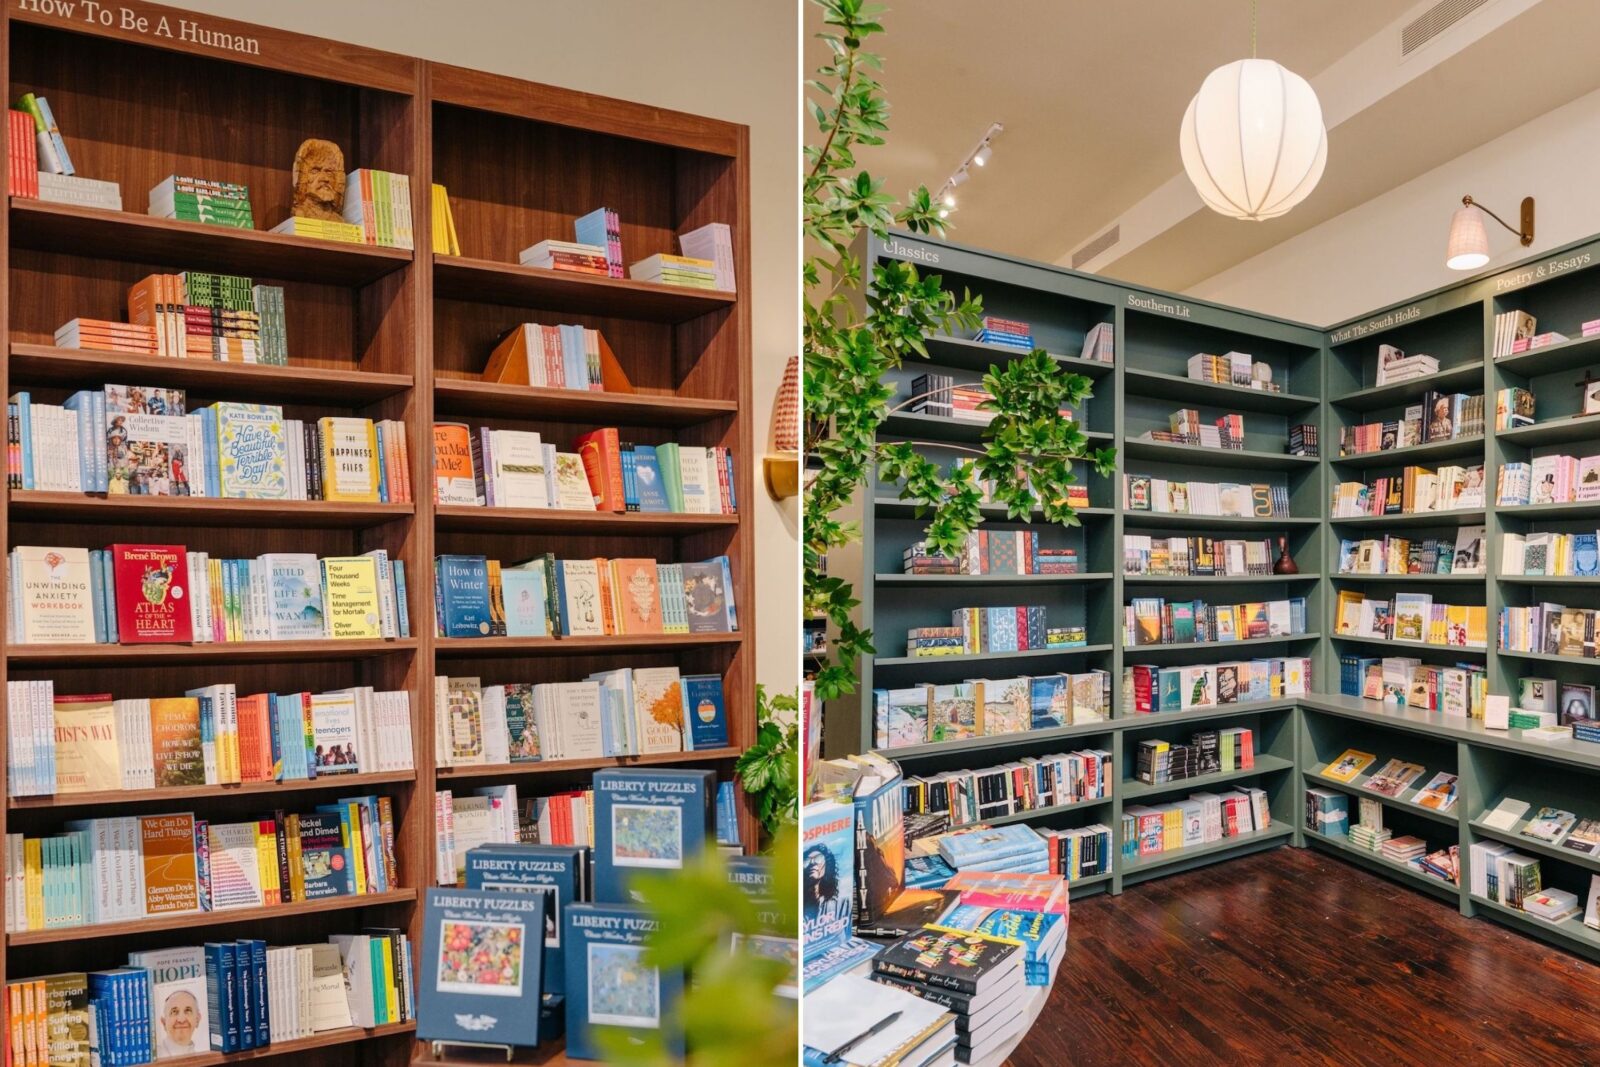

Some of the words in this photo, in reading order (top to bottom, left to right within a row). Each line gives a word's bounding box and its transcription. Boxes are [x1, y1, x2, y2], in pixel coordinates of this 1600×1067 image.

[81, 1, 113, 26] To
[119, 8, 148, 33] Be
[154, 16, 174, 38] A
[179, 20, 260, 55] Human
[884, 240, 940, 263] Classics
[1496, 271, 1534, 290] Poetry
[1536, 265, 1546, 278] &
[1549, 254, 1591, 274] Essays
[1128, 294, 1174, 314] Southern
[1175, 304, 1190, 317] Lit
[1330, 326, 1351, 343] What
[1352, 321, 1367, 336] The
[1369, 315, 1394, 332] South
[1395, 307, 1420, 324] Holds
[129, 415, 165, 425] Collective
[129, 424, 159, 433] Wisdom
[236, 425, 262, 442] Have
[435, 431, 447, 441] re
[231, 436, 276, 458] Beautiful
[450, 444, 469, 455] Mad
[330, 448, 372, 458] HAPPINESS
[236, 449, 272, 470] Terrible
[444, 458, 462, 471] Me?
[240, 462, 268, 484] Day!
[342, 464, 363, 472] FILES
[124, 552, 149, 561] Brené
[150, 552, 177, 561] Brown
[272, 568, 304, 577] BUILD
[449, 566, 470, 576] How
[474, 567, 483, 576] to
[26, 582, 86, 590] UNWINDING
[450, 579, 484, 589] Winter
[135, 603, 174, 612] ATLAS
[275, 612, 308, 621] WANT
[136, 620, 175, 629] HEART
[91, 724, 112, 741] WAY
[315, 726, 351, 734] teenagers
[646, 726, 670, 735] GOOD
[648, 736, 673, 745] DEATH
[600, 780, 646, 791] LIBERTY
[648, 782, 696, 793] PUZZLES
[160, 819, 175, 827] Can
[300, 819, 321, 828] Nickel
[144, 830, 164, 838] Hard
[165, 828, 192, 838] Things
[221, 828, 252, 836] CHARLES
[301, 828, 313, 836] and
[315, 826, 339, 835] Dimed
[803, 816, 851, 841] OSPHERE
[473, 859, 516, 870] LIBERTY
[519, 860, 566, 872] PUZZLES
[148, 886, 174, 894] Glennon
[176, 884, 194, 893] Doyle
[305, 888, 337, 896] Ehrenreich
[148, 894, 164, 903] Abby
[166, 892, 195, 900] Wambach
[176, 901, 194, 910] Doyle
[434, 896, 482, 908] LIBERTY
[484, 898, 534, 911] PUZZLES
[573, 915, 621, 929] LIBERTY
[623, 918, 660, 931] PUZZ
[153, 964, 201, 983] HOPE
[49, 1000, 72, 1009] Days
[49, 1014, 82, 1024] Surfing
[54, 1026, 69, 1034] Life
